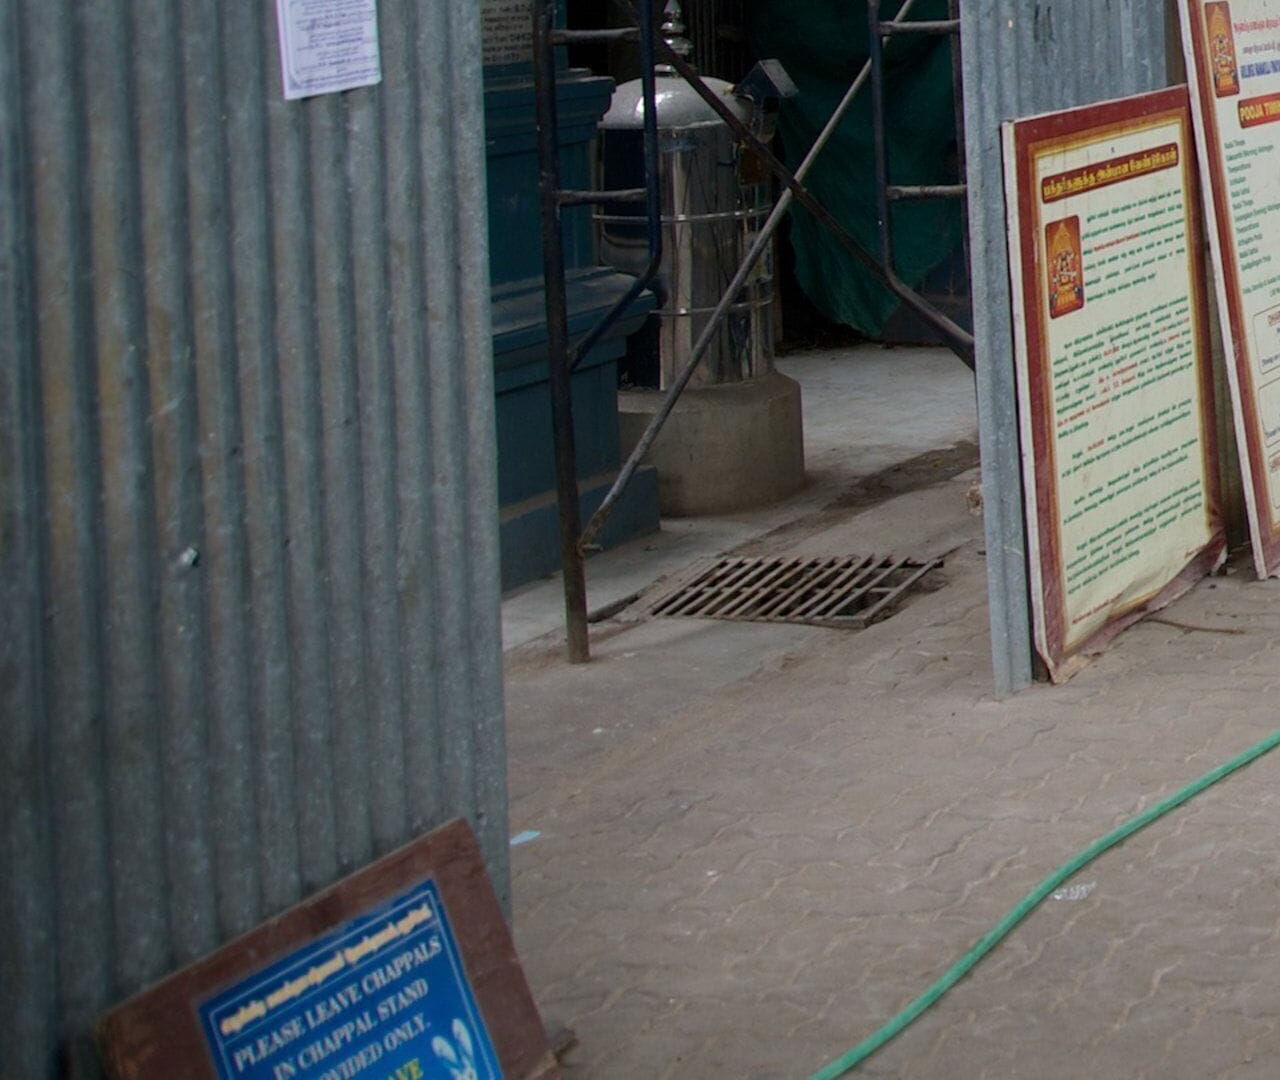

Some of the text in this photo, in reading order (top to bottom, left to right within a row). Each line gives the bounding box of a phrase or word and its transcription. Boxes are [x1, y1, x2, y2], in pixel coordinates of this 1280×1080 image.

[233, 1015, 308, 1073] PLEASE
[304, 981, 364, 1031] LEAVE
[360, 935, 444, 997] CHAPPALS
[297, 1010, 378, 1071] CHAPPAL
[376, 977, 430, 1025] STAND
